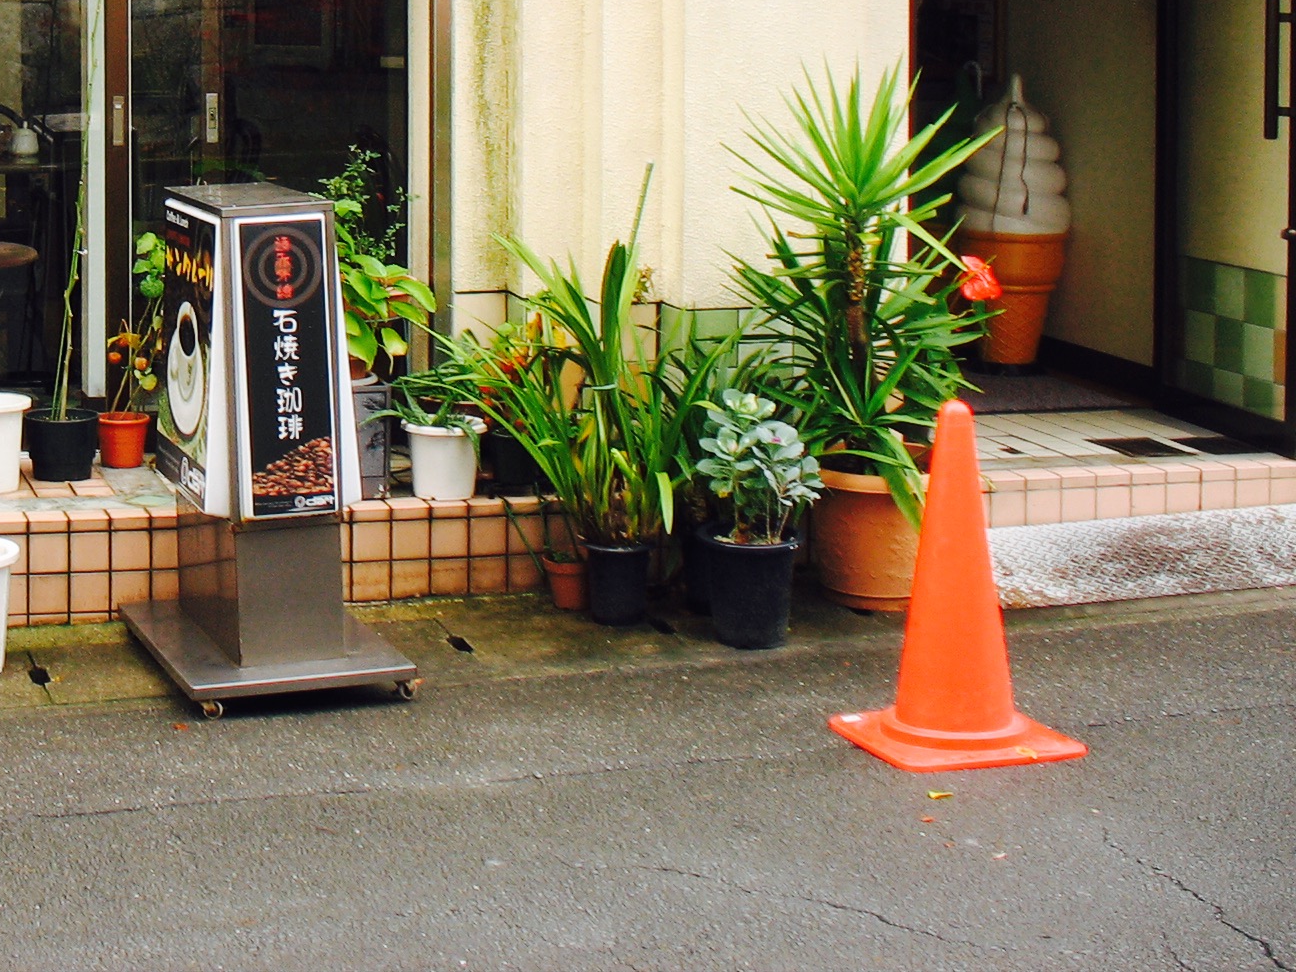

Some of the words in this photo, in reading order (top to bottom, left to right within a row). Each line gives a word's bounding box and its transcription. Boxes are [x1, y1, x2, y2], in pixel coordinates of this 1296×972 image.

[273, 309, 303, 440] 石焼き珈琲
